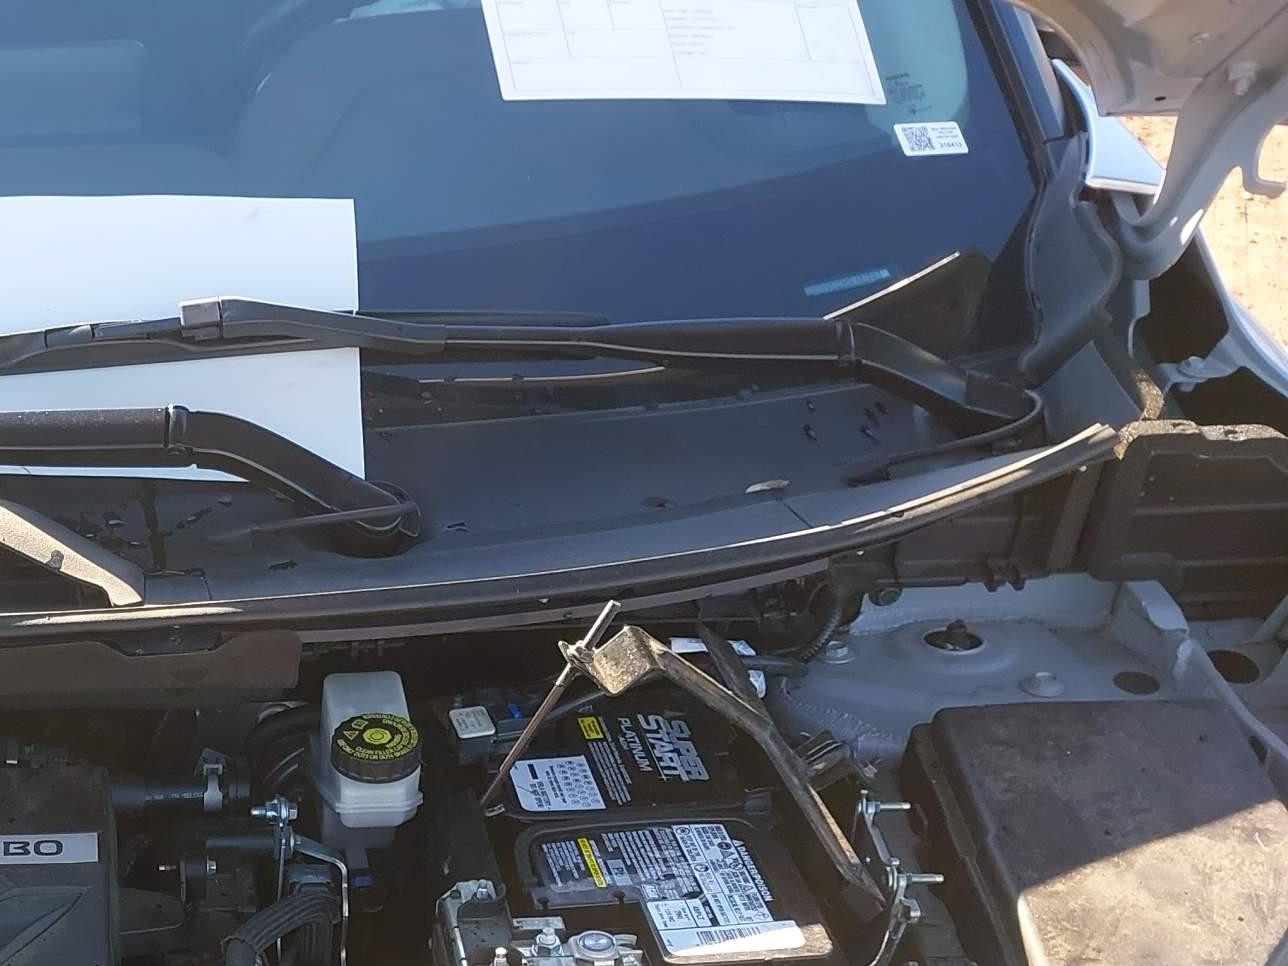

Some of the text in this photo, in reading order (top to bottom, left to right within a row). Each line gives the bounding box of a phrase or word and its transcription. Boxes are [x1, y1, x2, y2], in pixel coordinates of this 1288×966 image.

[617, 717, 654, 772] PLATINUM
[637, 714, 690, 782] START
[664, 719, 710, 780] SUPER
[738, 846, 774, 902] DANGER/POISON
